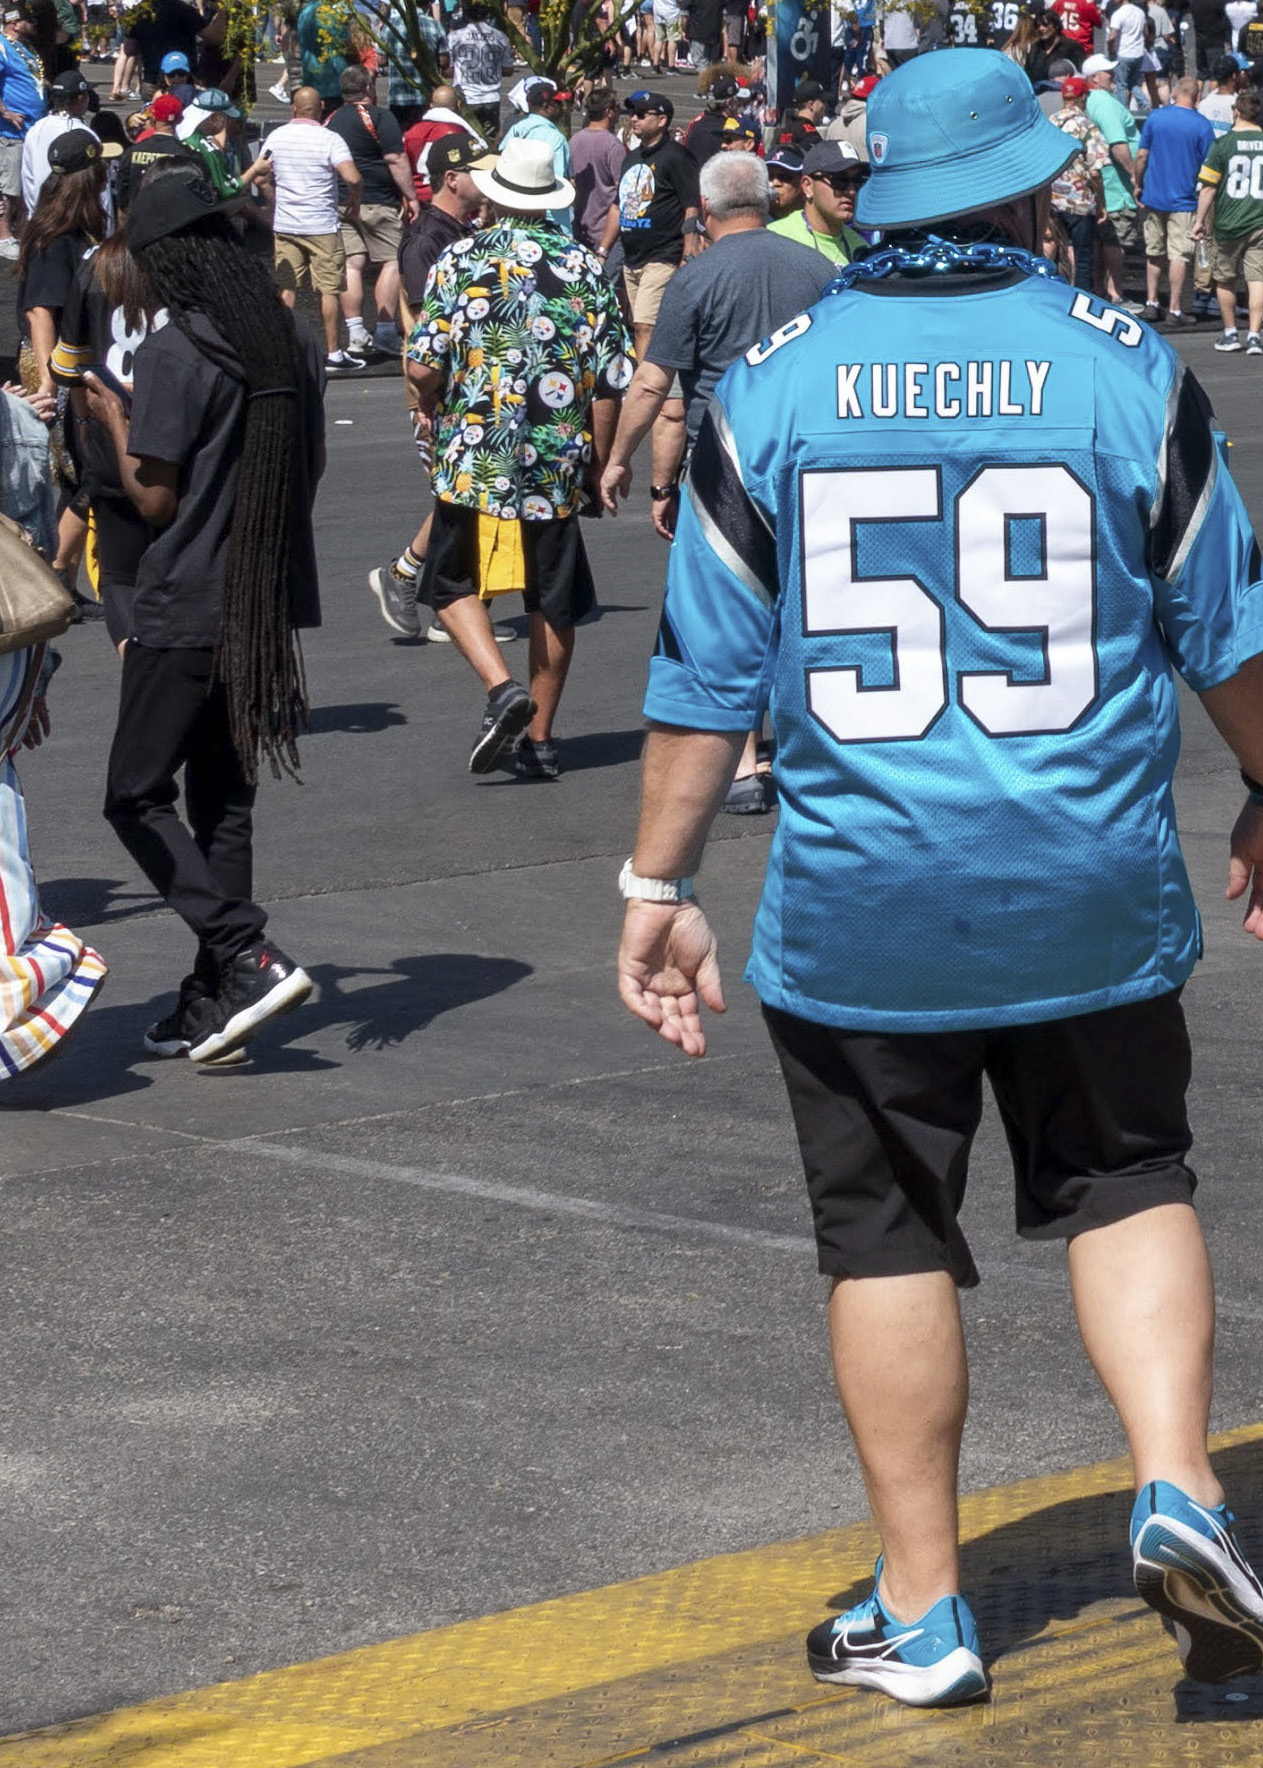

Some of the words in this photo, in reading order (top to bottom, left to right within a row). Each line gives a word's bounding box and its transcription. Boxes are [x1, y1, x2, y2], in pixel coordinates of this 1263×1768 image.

[951, 14, 977, 43] 34
[992, 2, 1019, 30] 36
[1059, 11, 1079, 30] 15
[460, 43, 501, 85] 28
[836, 360, 1053, 420] KUECHLY
[799, 463, 1099, 745] 59
